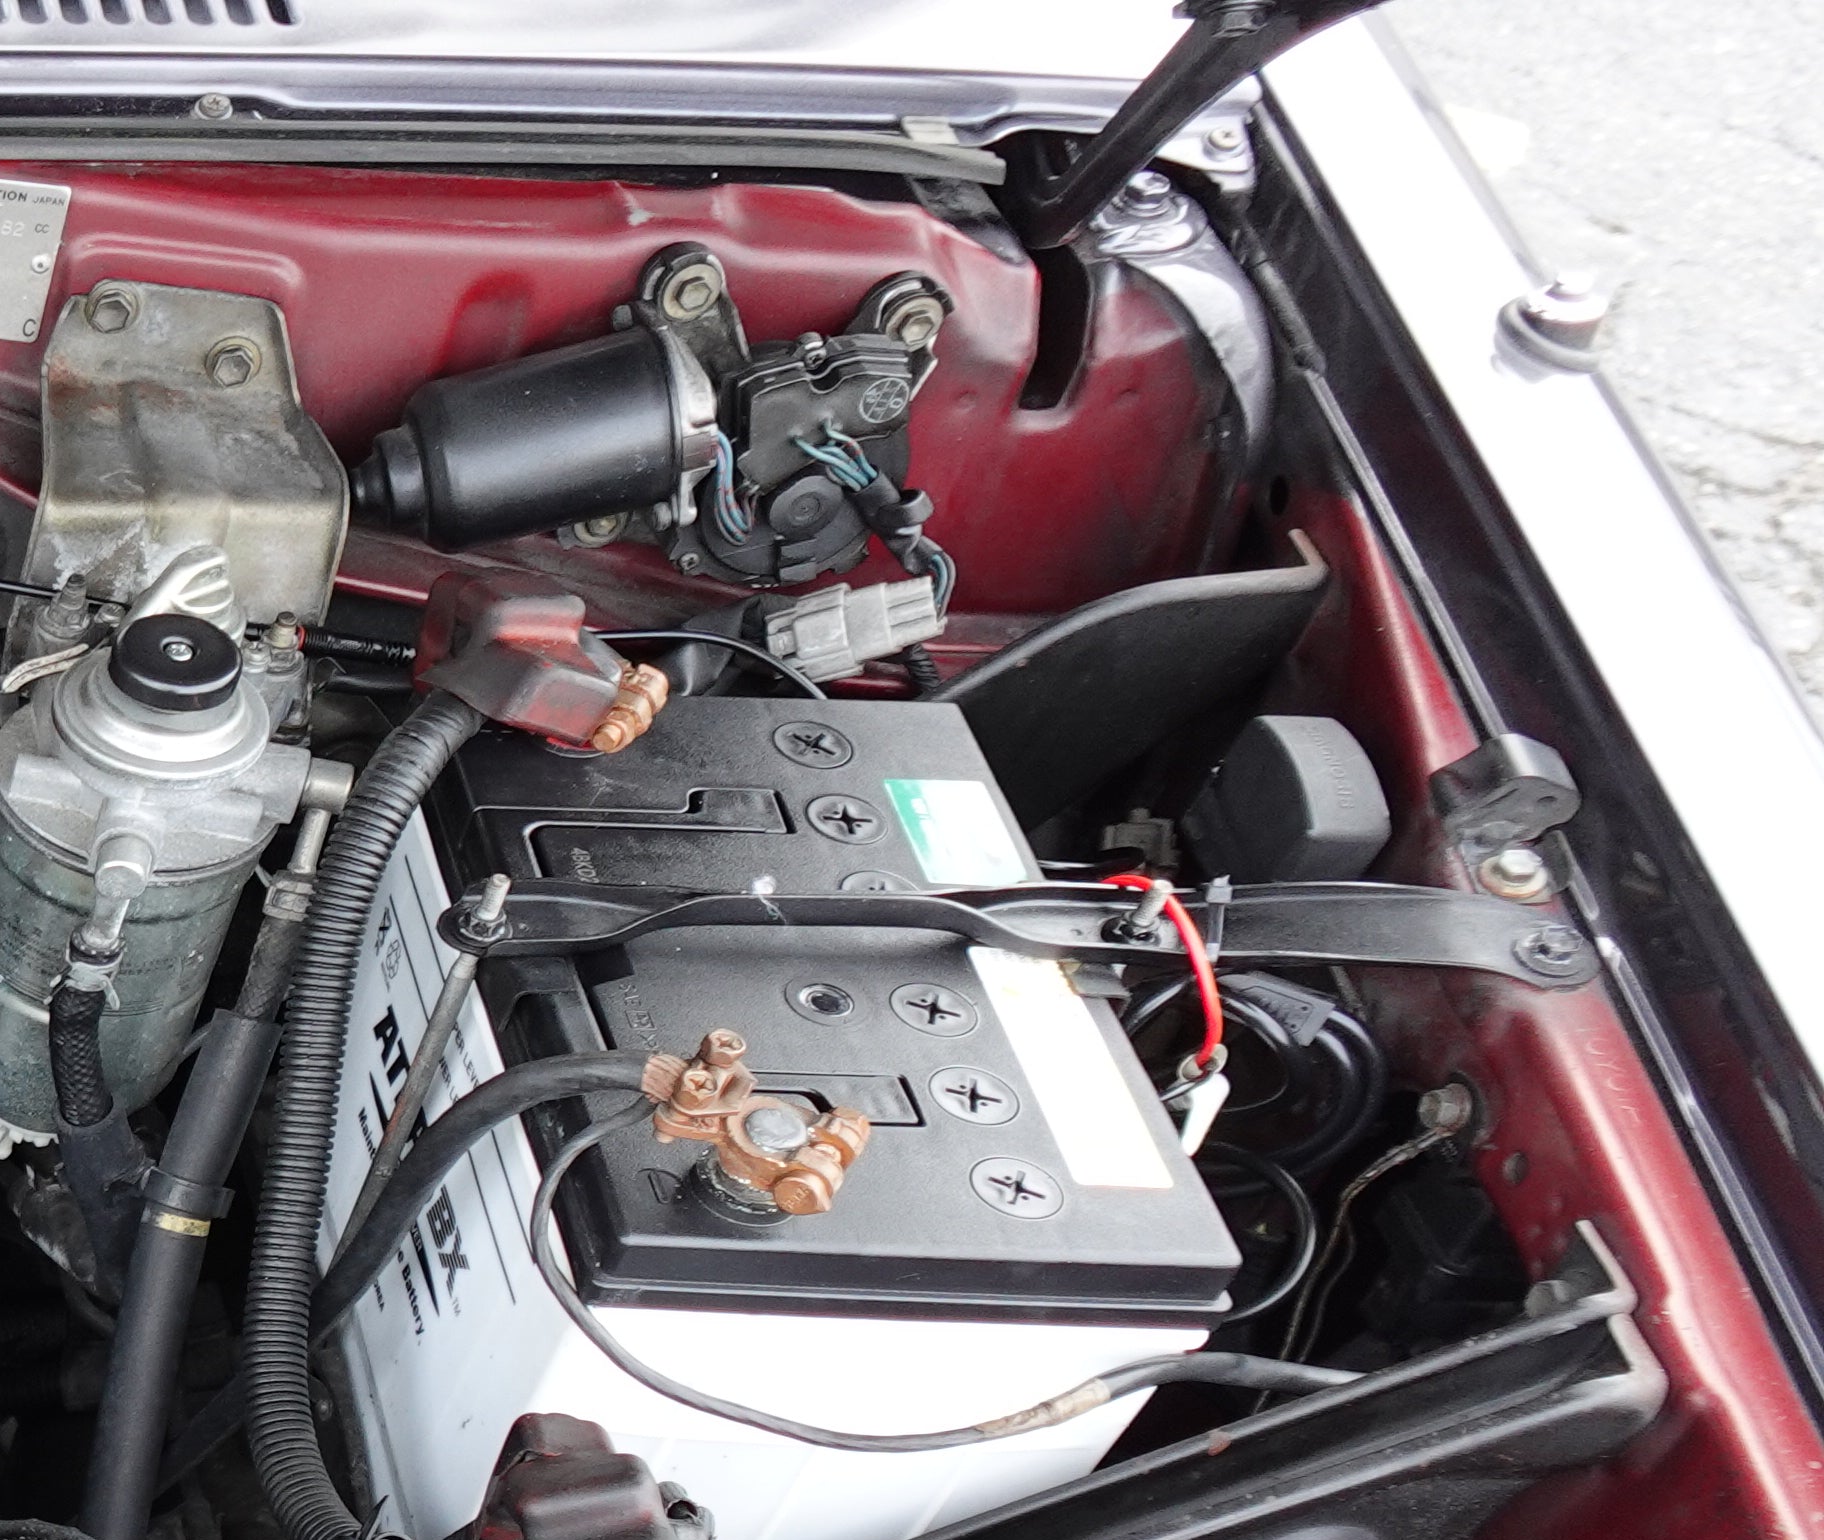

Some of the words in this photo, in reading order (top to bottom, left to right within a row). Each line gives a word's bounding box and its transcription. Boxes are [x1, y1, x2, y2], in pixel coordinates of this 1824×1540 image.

[32, 196, 65, 207] JAPAN
[34, 222, 51, 234] CC
[22, 318, 36, 338] C
